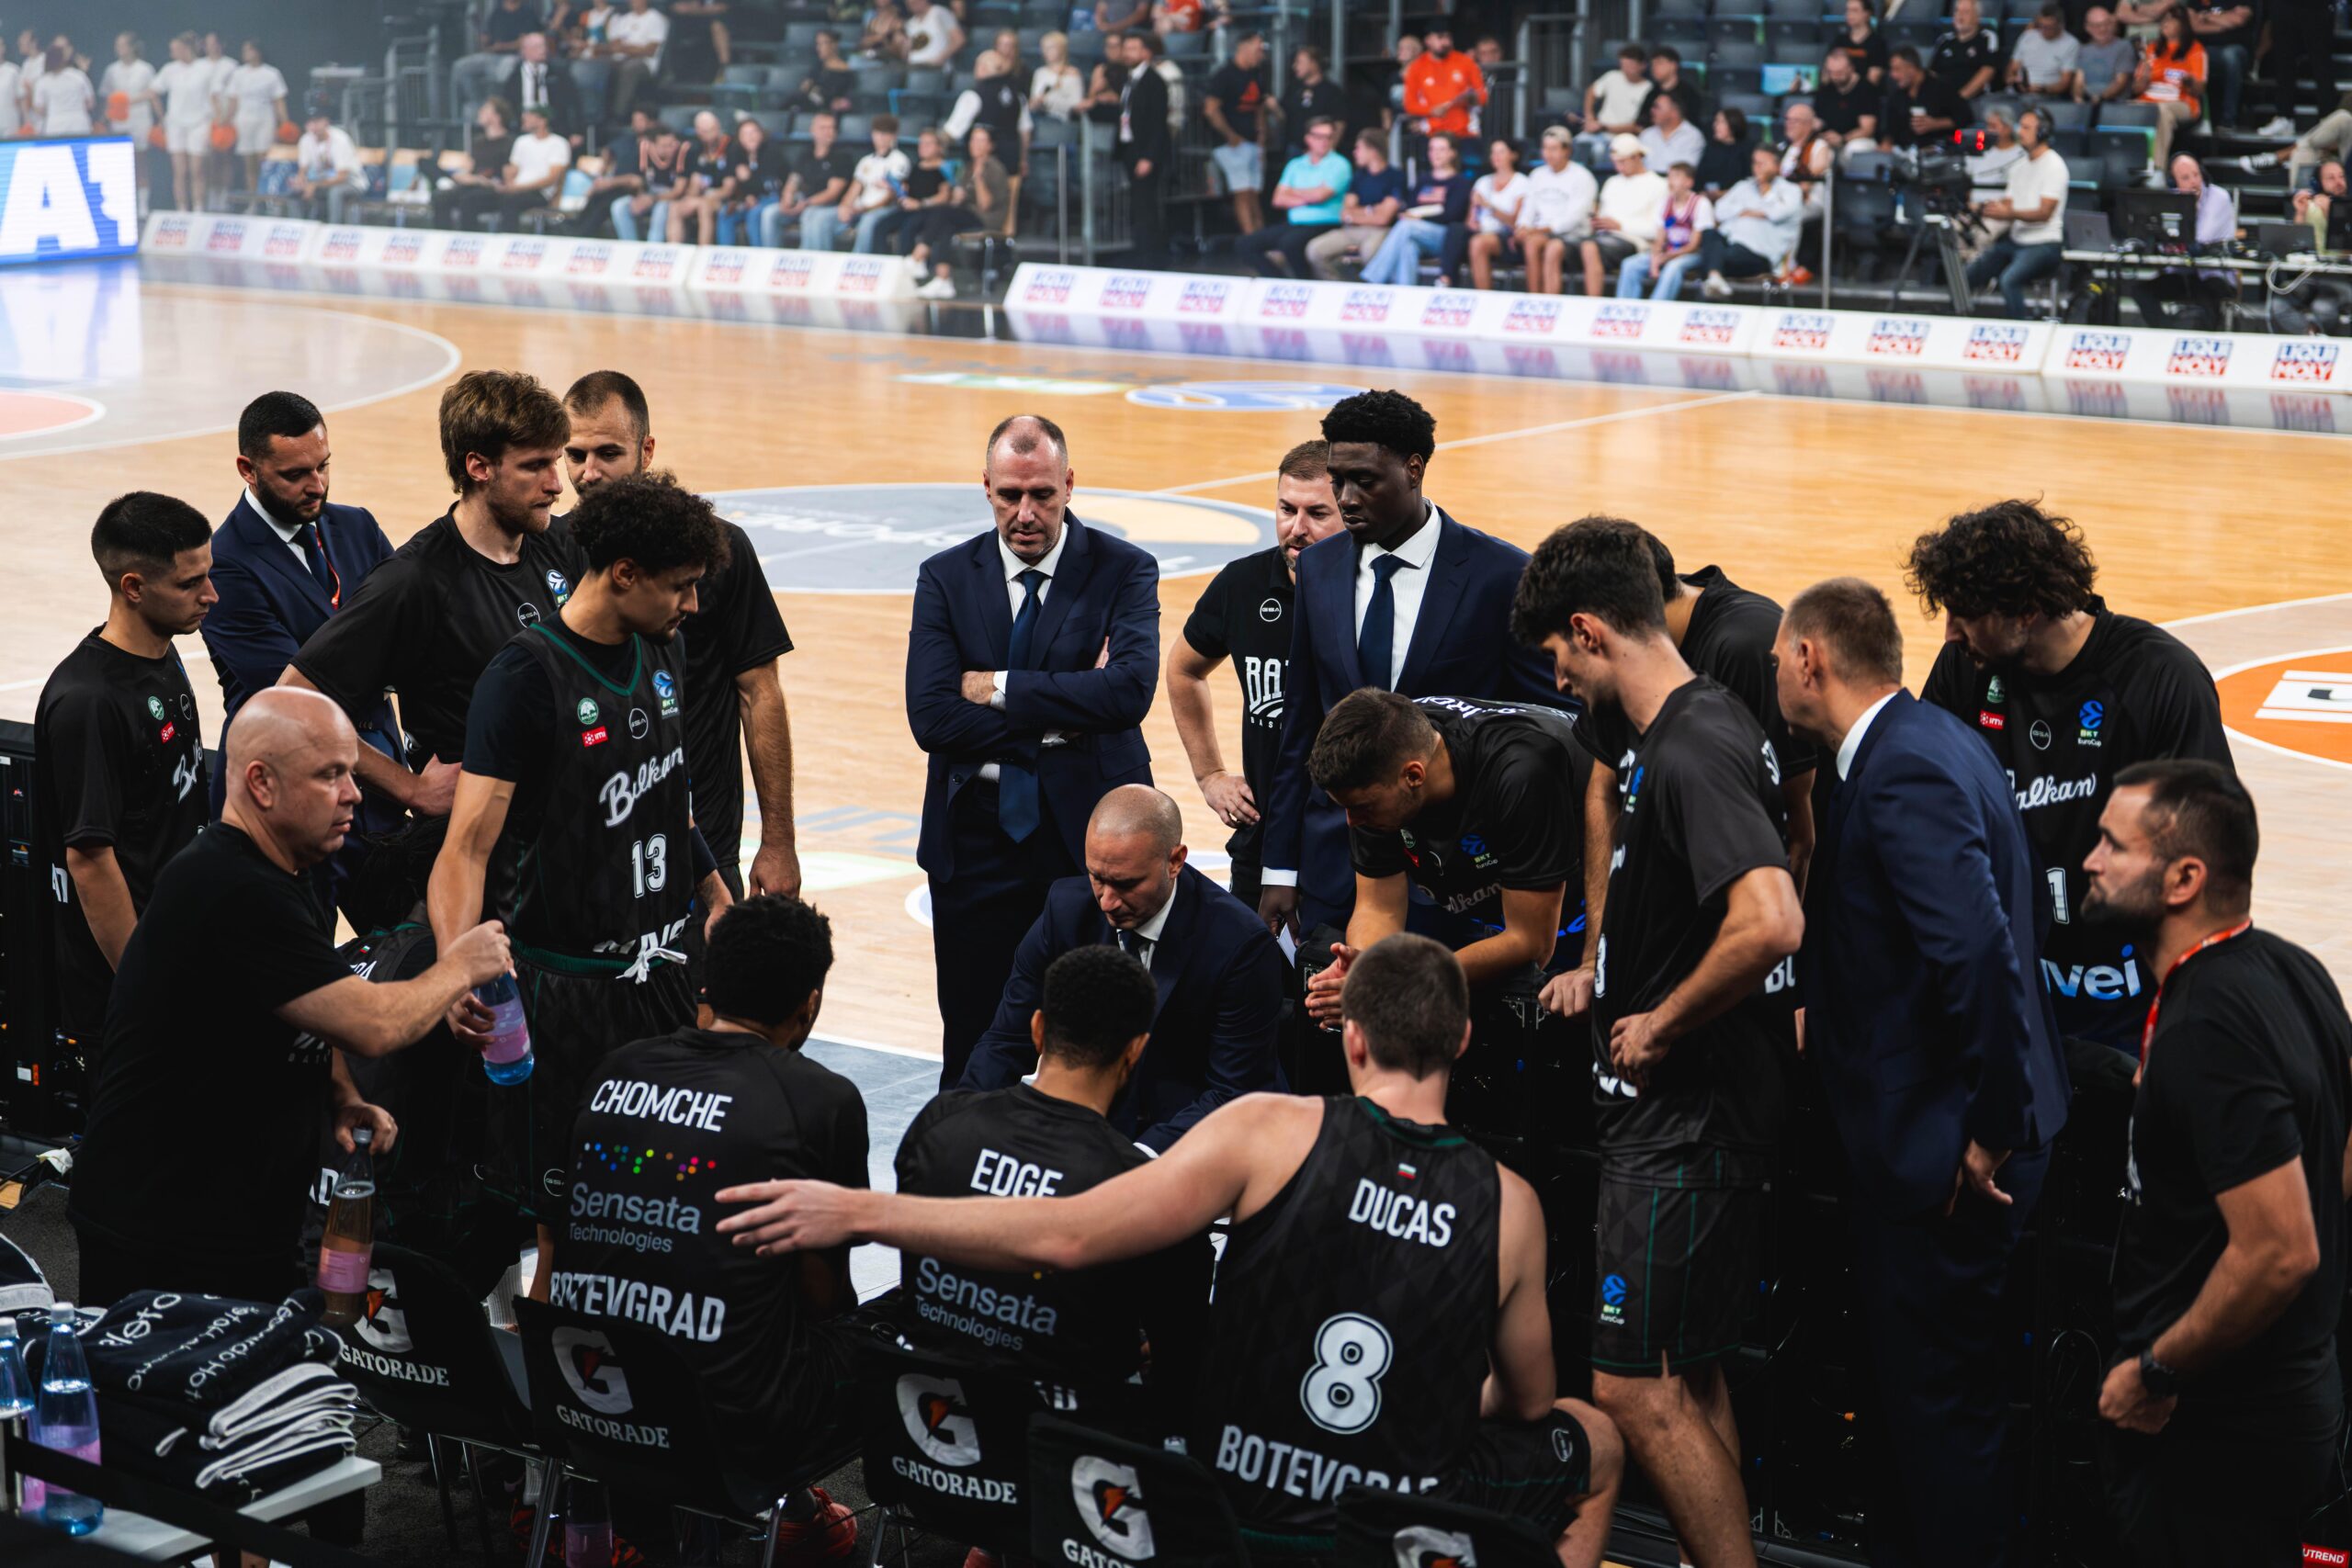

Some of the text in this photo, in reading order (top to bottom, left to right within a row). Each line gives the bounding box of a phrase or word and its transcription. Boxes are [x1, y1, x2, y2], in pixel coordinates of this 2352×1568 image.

[1244, 655, 1290, 713] BA
[631, 832, 667, 899] 13
[2038, 942, 2142, 1001] vei
[590, 1078, 733, 1133] CHOMCHE
[970, 1148, 1064, 1198] EDGE
[570, 1181, 701, 1235] Sensata
[1348, 1178, 1457, 1247] DUCAS
[569, 1222, 673, 1254] Technologies
[914, 1294, 1023, 1352] Technologies
[915, 1257, 1058, 1336] Sensata
[339, 1343, 450, 1387] GATORADE
[1299, 1311, 1395, 1435] 8
[556, 1404, 671, 1450] GATORADE
[891, 1455, 1018, 1506] GATORADE
